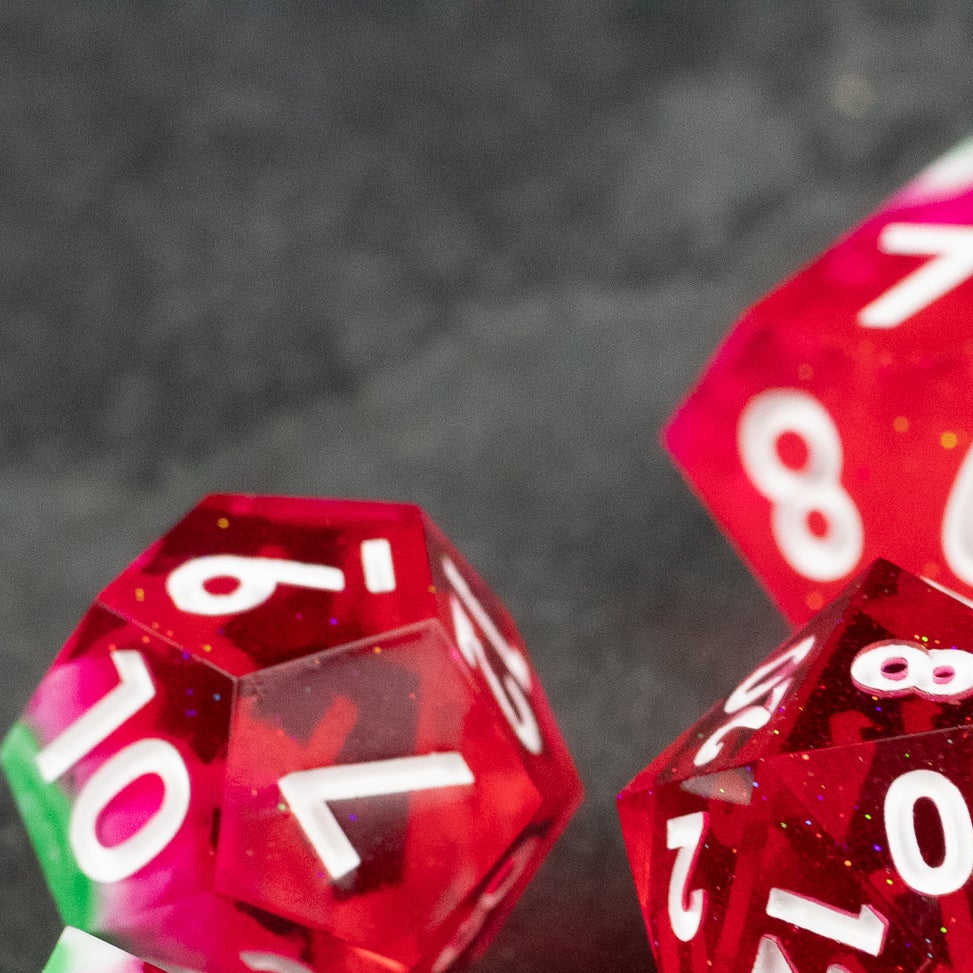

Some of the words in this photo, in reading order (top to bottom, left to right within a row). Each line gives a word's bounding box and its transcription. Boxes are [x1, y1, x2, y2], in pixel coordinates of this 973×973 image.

[737, 387, 865, 582] 8
[36, 648, 191, 884] 10
[278, 751, 475, 880] 7
